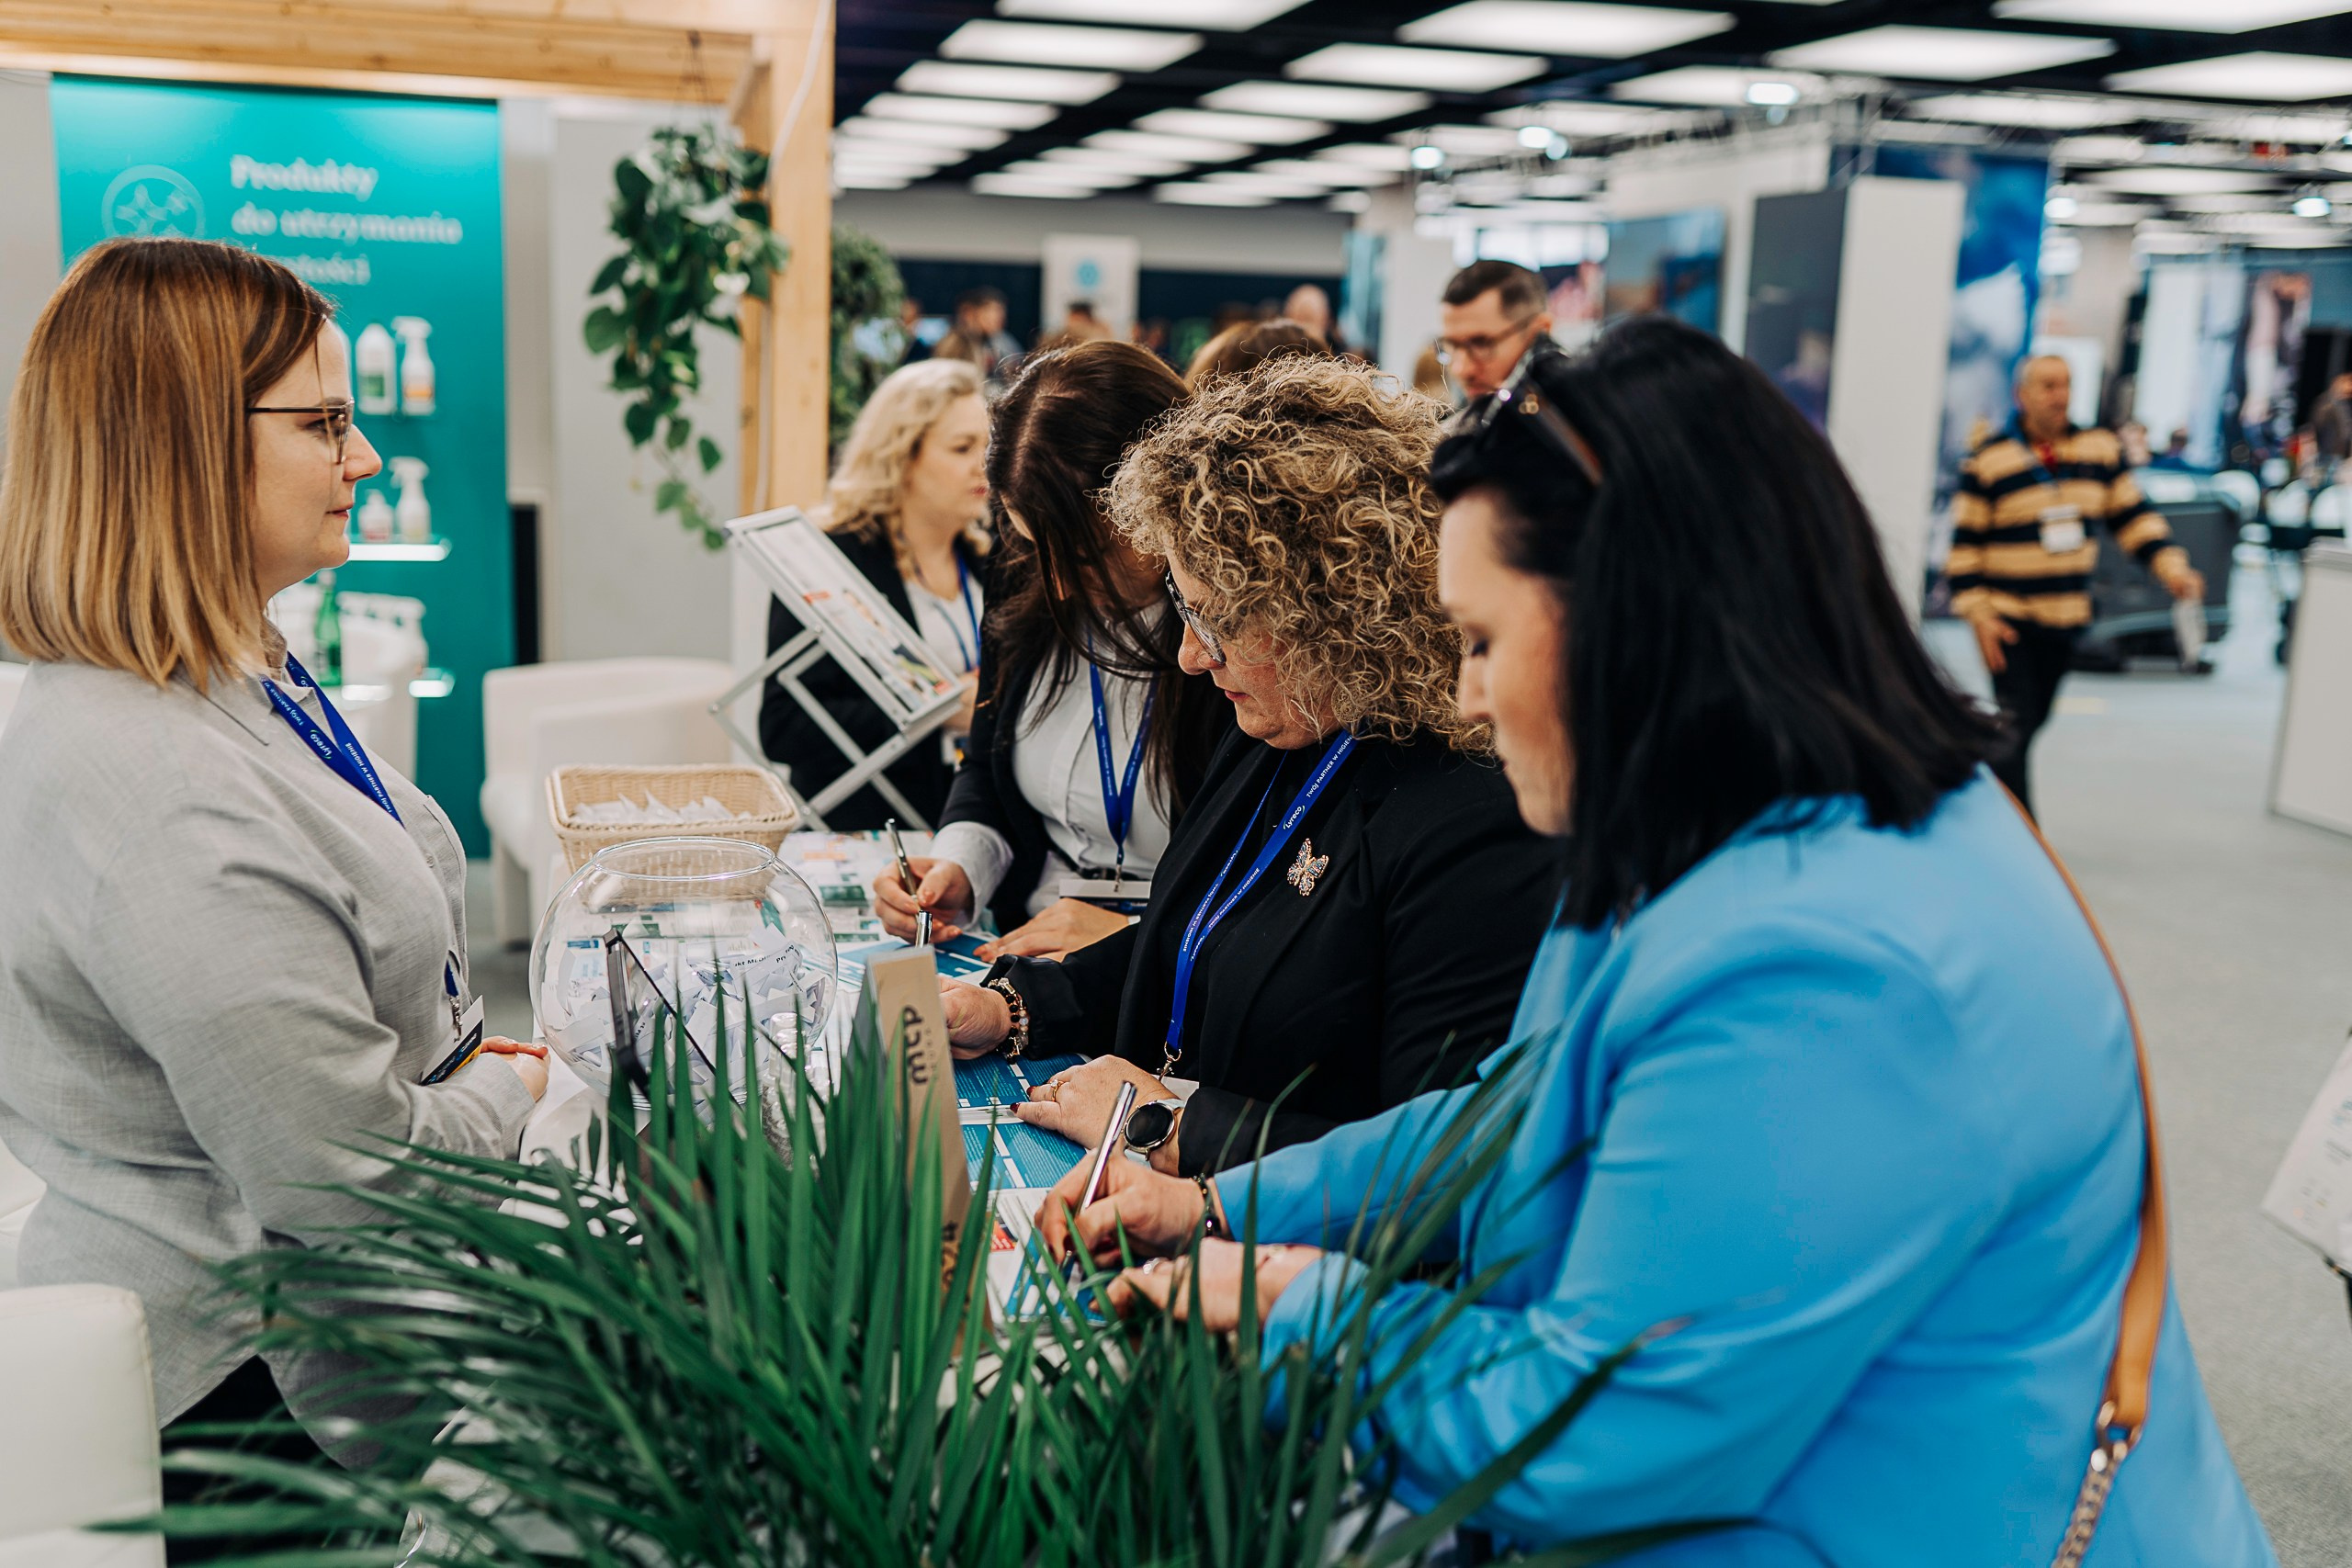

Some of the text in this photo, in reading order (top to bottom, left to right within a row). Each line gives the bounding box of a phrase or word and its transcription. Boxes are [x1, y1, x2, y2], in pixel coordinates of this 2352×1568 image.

[230, 154, 379, 202] Produkty
[232, 201, 277, 236] do
[311, 733, 332, 758] Lyreco
[366, 773, 382, 798] PARTNER
[1285, 805, 1304, 829] Lyreco
[1306, 783, 1318, 797] TWÓJ
[1317, 761, 1334, 783] PARTNER
